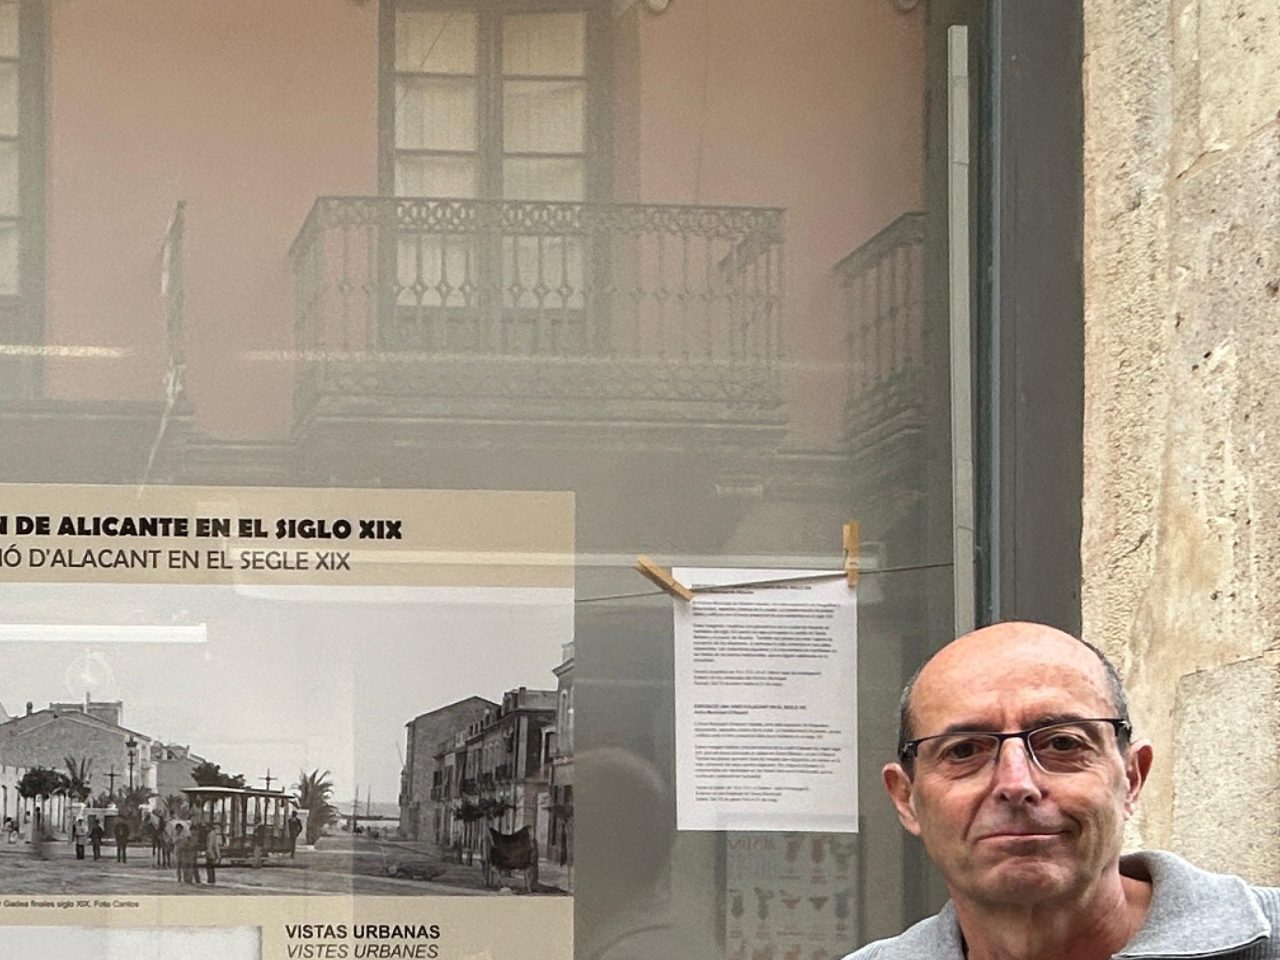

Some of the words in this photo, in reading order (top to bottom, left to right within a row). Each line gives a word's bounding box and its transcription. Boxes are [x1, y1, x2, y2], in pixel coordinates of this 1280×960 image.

[16, 516, 50, 535] DE
[57, 516, 188, 537] ALICANTE
[196, 518, 230, 538] EN
[238, 518, 268, 538] EL
[275, 518, 352, 539] SIGLO
[359, 520, 402, 540] XIX
[29, 548, 161, 569] D'ALACANT
[168, 550, 199, 569] EN
[207, 551, 233, 569] EL
[240, 551, 309, 570] SEGLE
[316, 552, 351, 571] XIX
[285, 924, 347, 939] VISTAS
[353, 924, 440, 939] URBANAS
[286, 944, 348, 959] VISTES
[353, 944, 439, 959] URBANES
